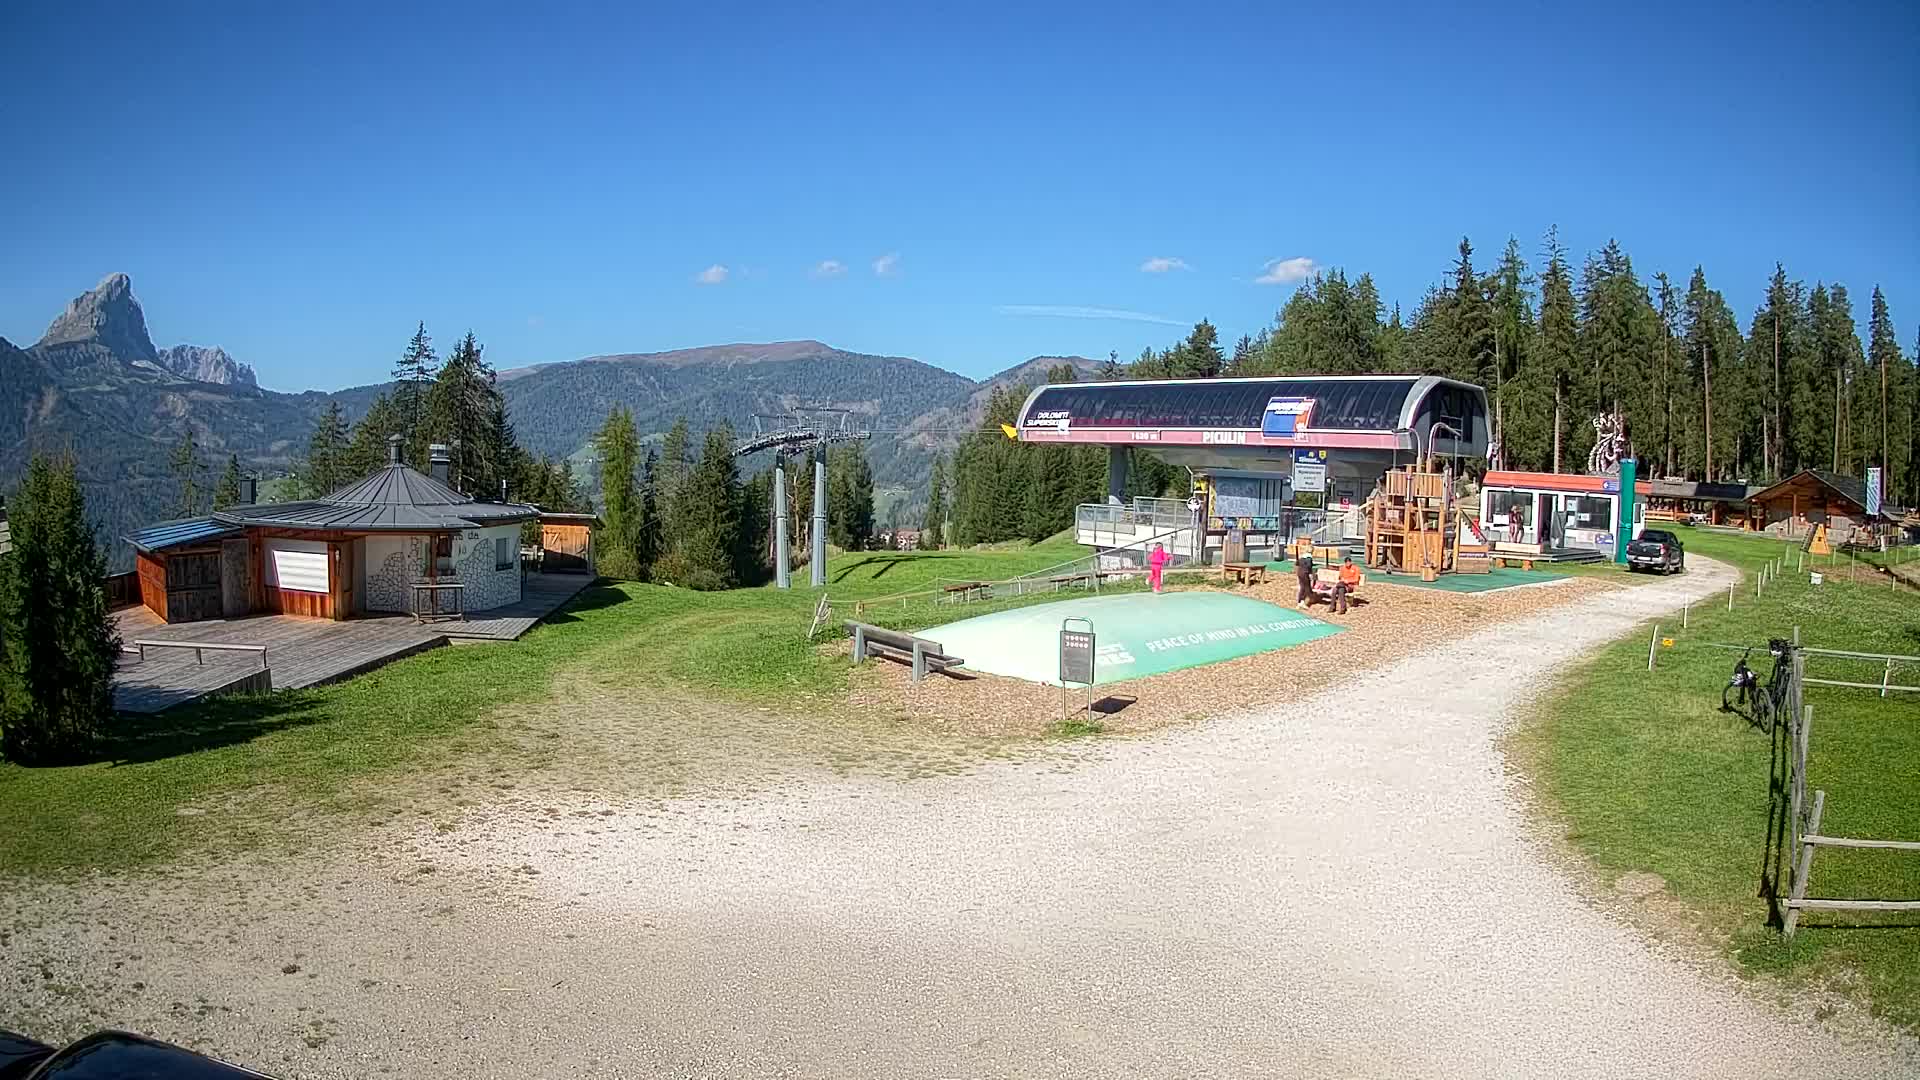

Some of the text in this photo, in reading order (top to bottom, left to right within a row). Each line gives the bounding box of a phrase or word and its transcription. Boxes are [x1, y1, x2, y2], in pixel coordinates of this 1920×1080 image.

[1037, 411, 1070, 419] DOLOMITI
[1202, 431, 1246, 444] PICULIN
[1145, 635, 1190, 653] PEACE
[1187, 633, 1206, 646] OF
[1206, 629, 1236, 641] MIND
[1235, 627, 1250, 638] IN
[1248, 624, 1270, 635] ALL
